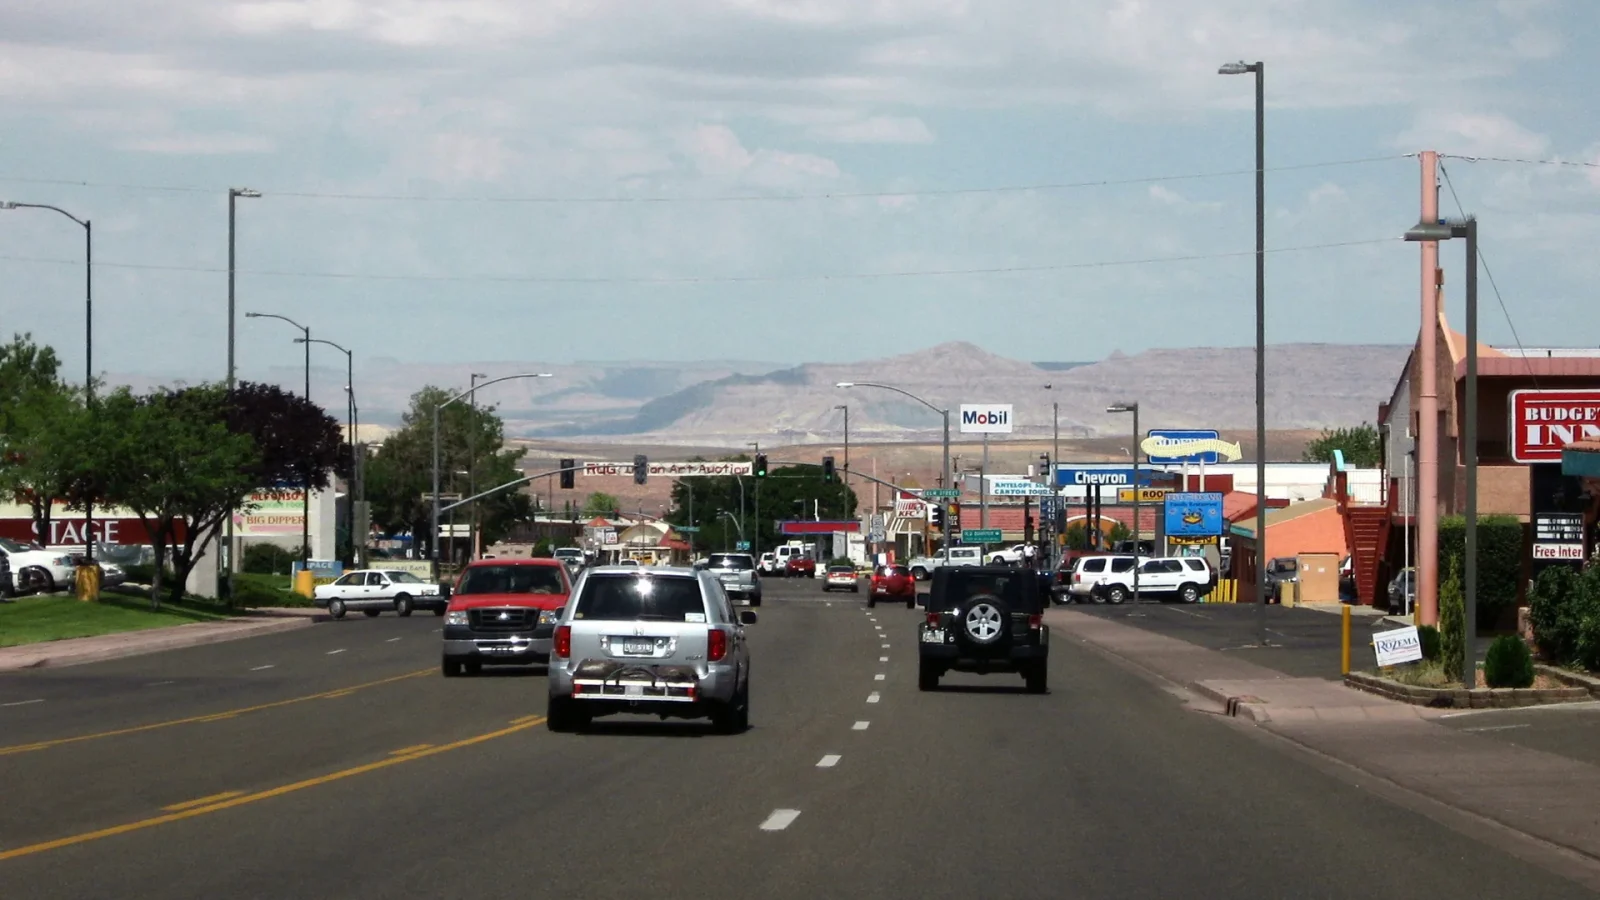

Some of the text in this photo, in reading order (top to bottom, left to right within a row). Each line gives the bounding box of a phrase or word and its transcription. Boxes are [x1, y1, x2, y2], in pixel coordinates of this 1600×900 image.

[963, 411, 1007, 424] Mobil
[1525, 407, 1600, 420] BUDGE
[587, 463, 616, 475] RUG
[670, 464, 694, 474] Art
[699, 463, 750, 475] Auction
[1075, 471, 1127, 484] Chevron
[1142, 490, 1164, 498] ROO
[246, 516, 306, 525] BIG DIPPER
[1535, 546, 1582, 557] Free Inter
